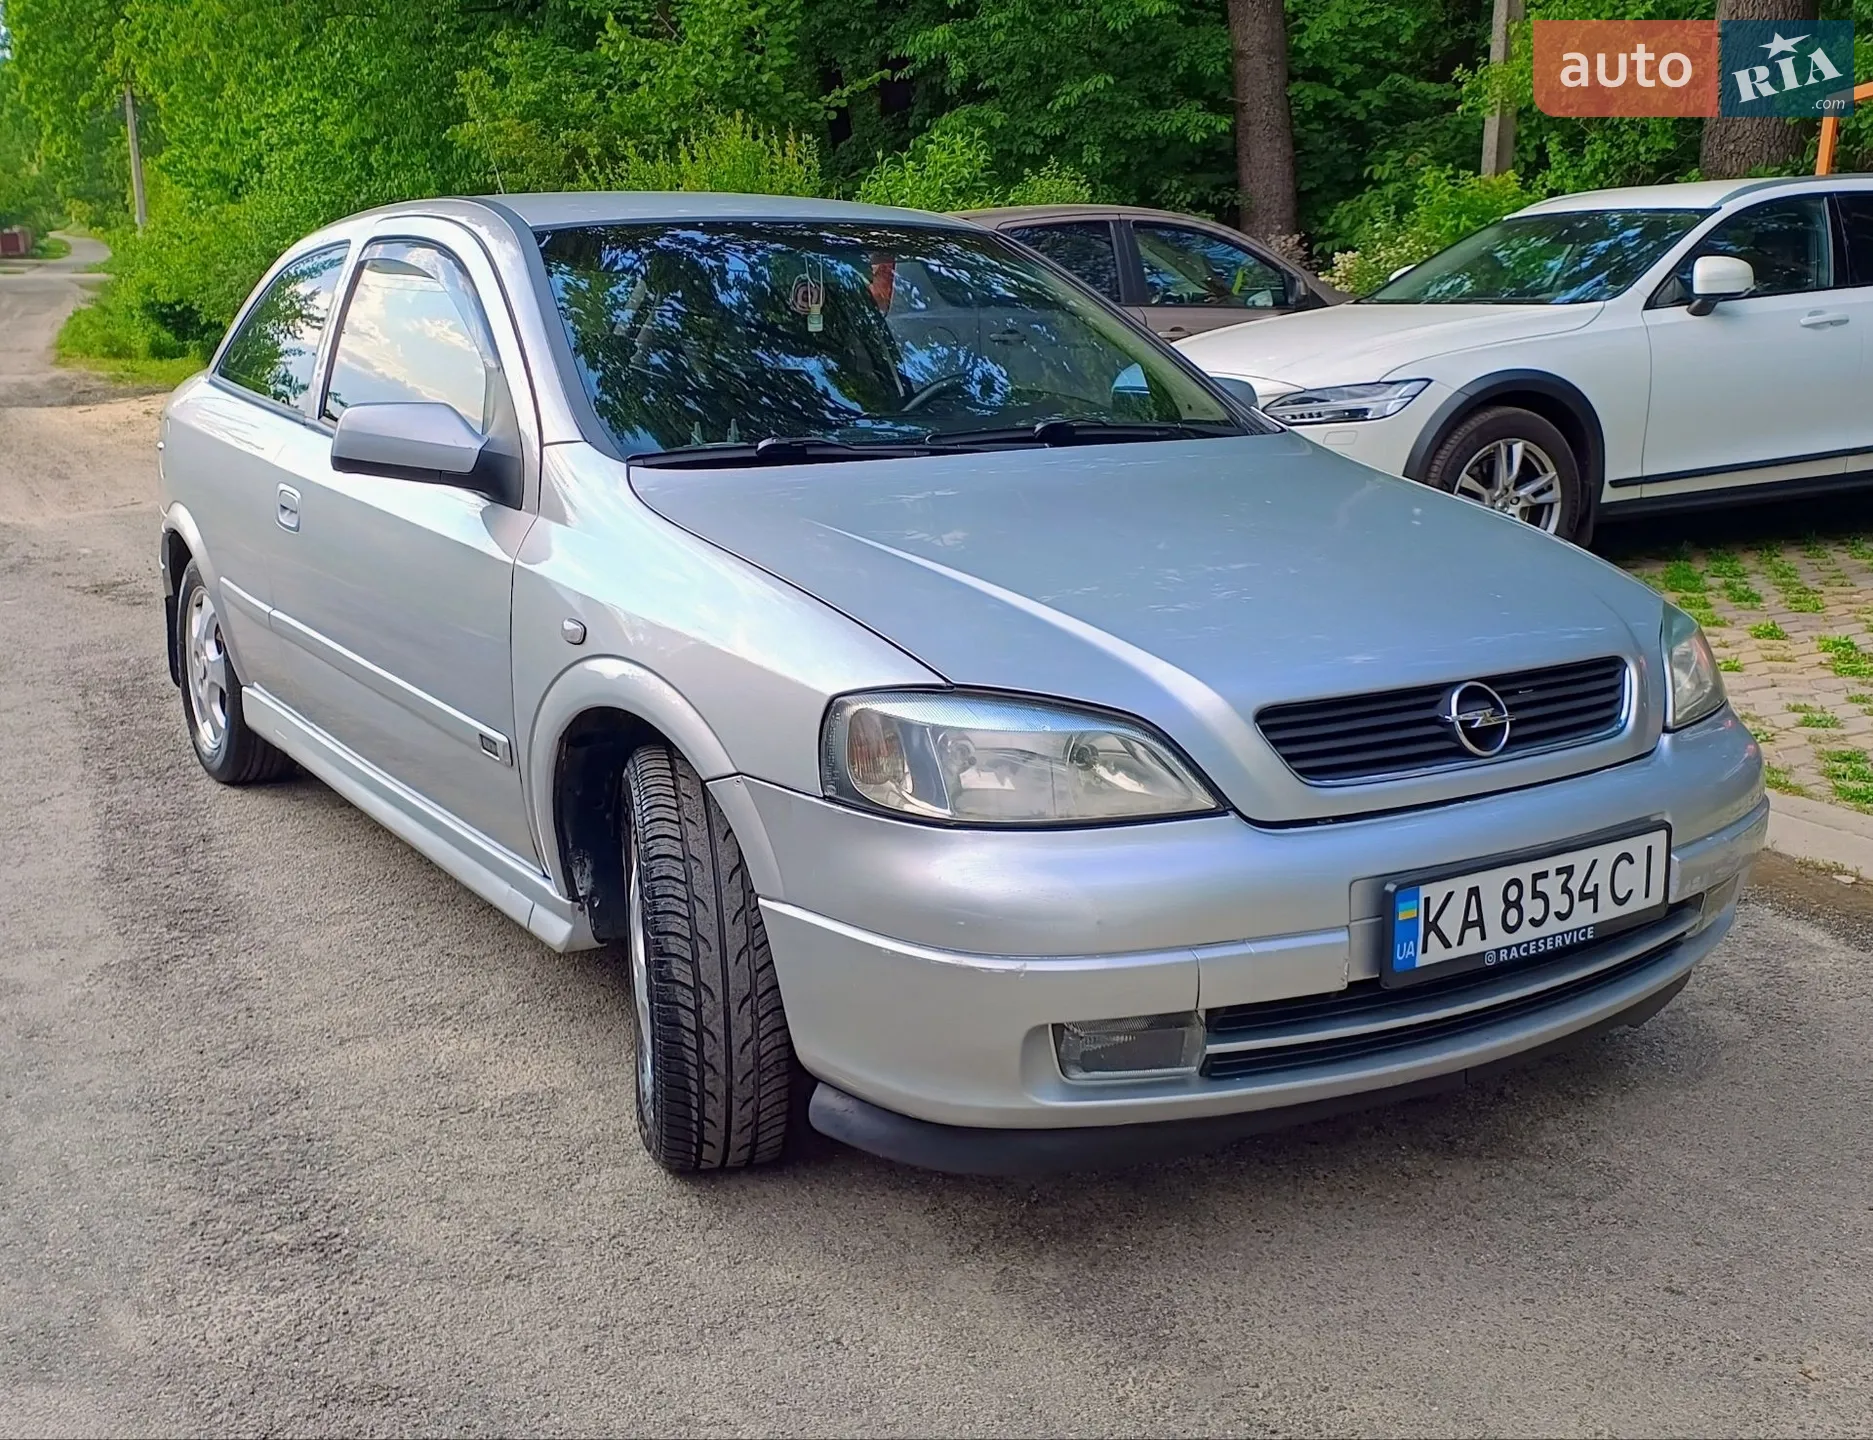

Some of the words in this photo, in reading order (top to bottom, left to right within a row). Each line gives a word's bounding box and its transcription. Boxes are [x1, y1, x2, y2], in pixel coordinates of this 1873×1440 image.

[1420, 885, 1487, 955] KA
[1500, 858, 1600, 935] 8534
[1609, 845, 1653, 907] CI
[1396, 940, 1415, 961] UA
[1499, 925, 1596, 962] RACESERVICE
